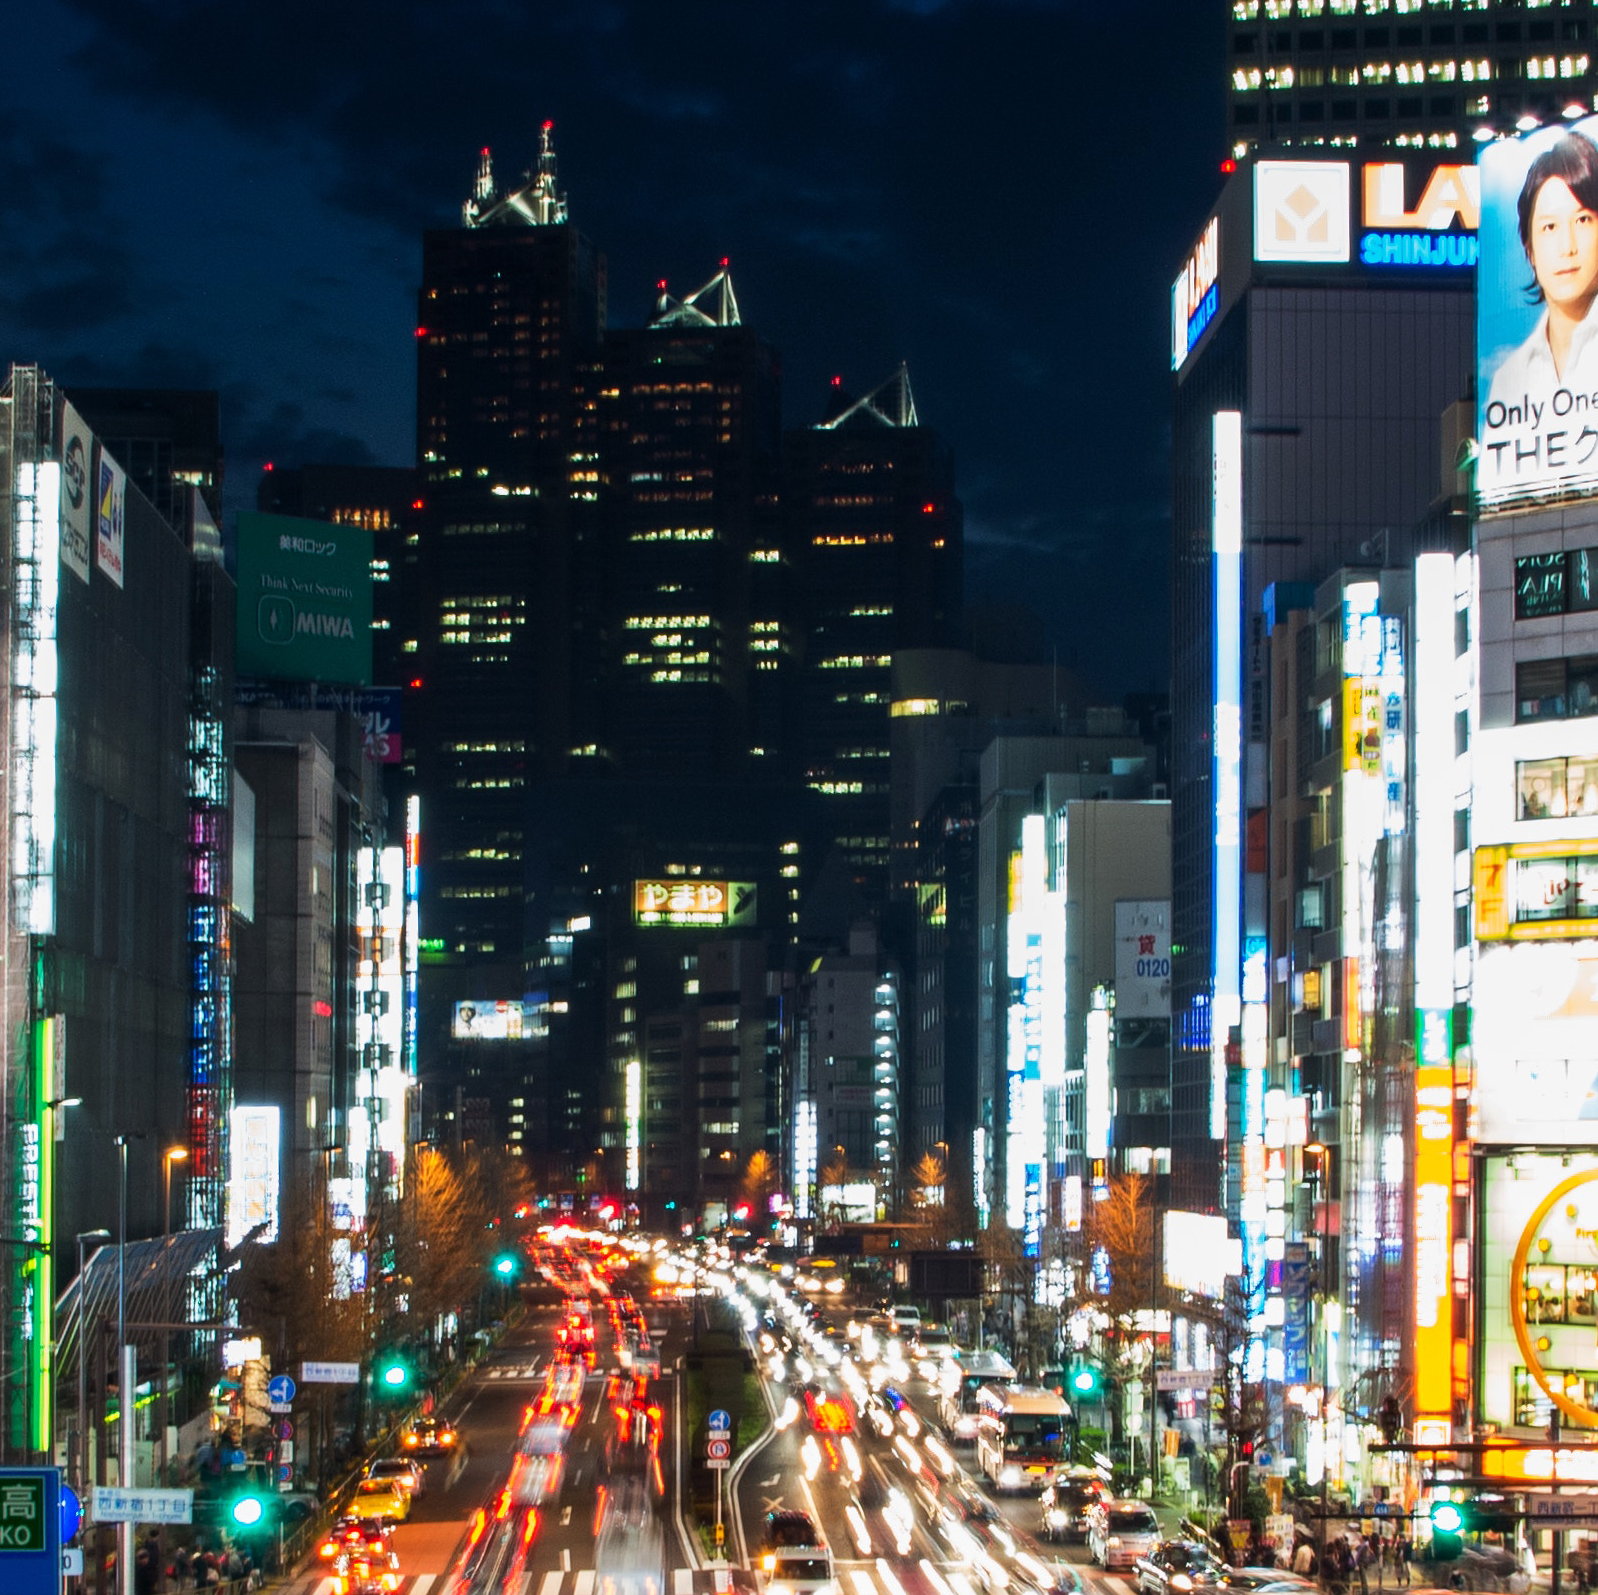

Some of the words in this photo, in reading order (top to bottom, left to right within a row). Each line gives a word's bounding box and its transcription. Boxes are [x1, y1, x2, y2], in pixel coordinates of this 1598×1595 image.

[1487, 394, 1544, 430] Only
[278, 534, 336, 555] 美和ロック
[260, 573, 288, 590] Think
[291, 579, 315, 594] Next
[315, 583, 354, 599] Security
[296, 612, 354, 639] MIWA
[643, 883, 724, 911] やまや
[1137, 958, 1170, 977] 0120
[19, 1123, 39, 1243] PRESTIA
